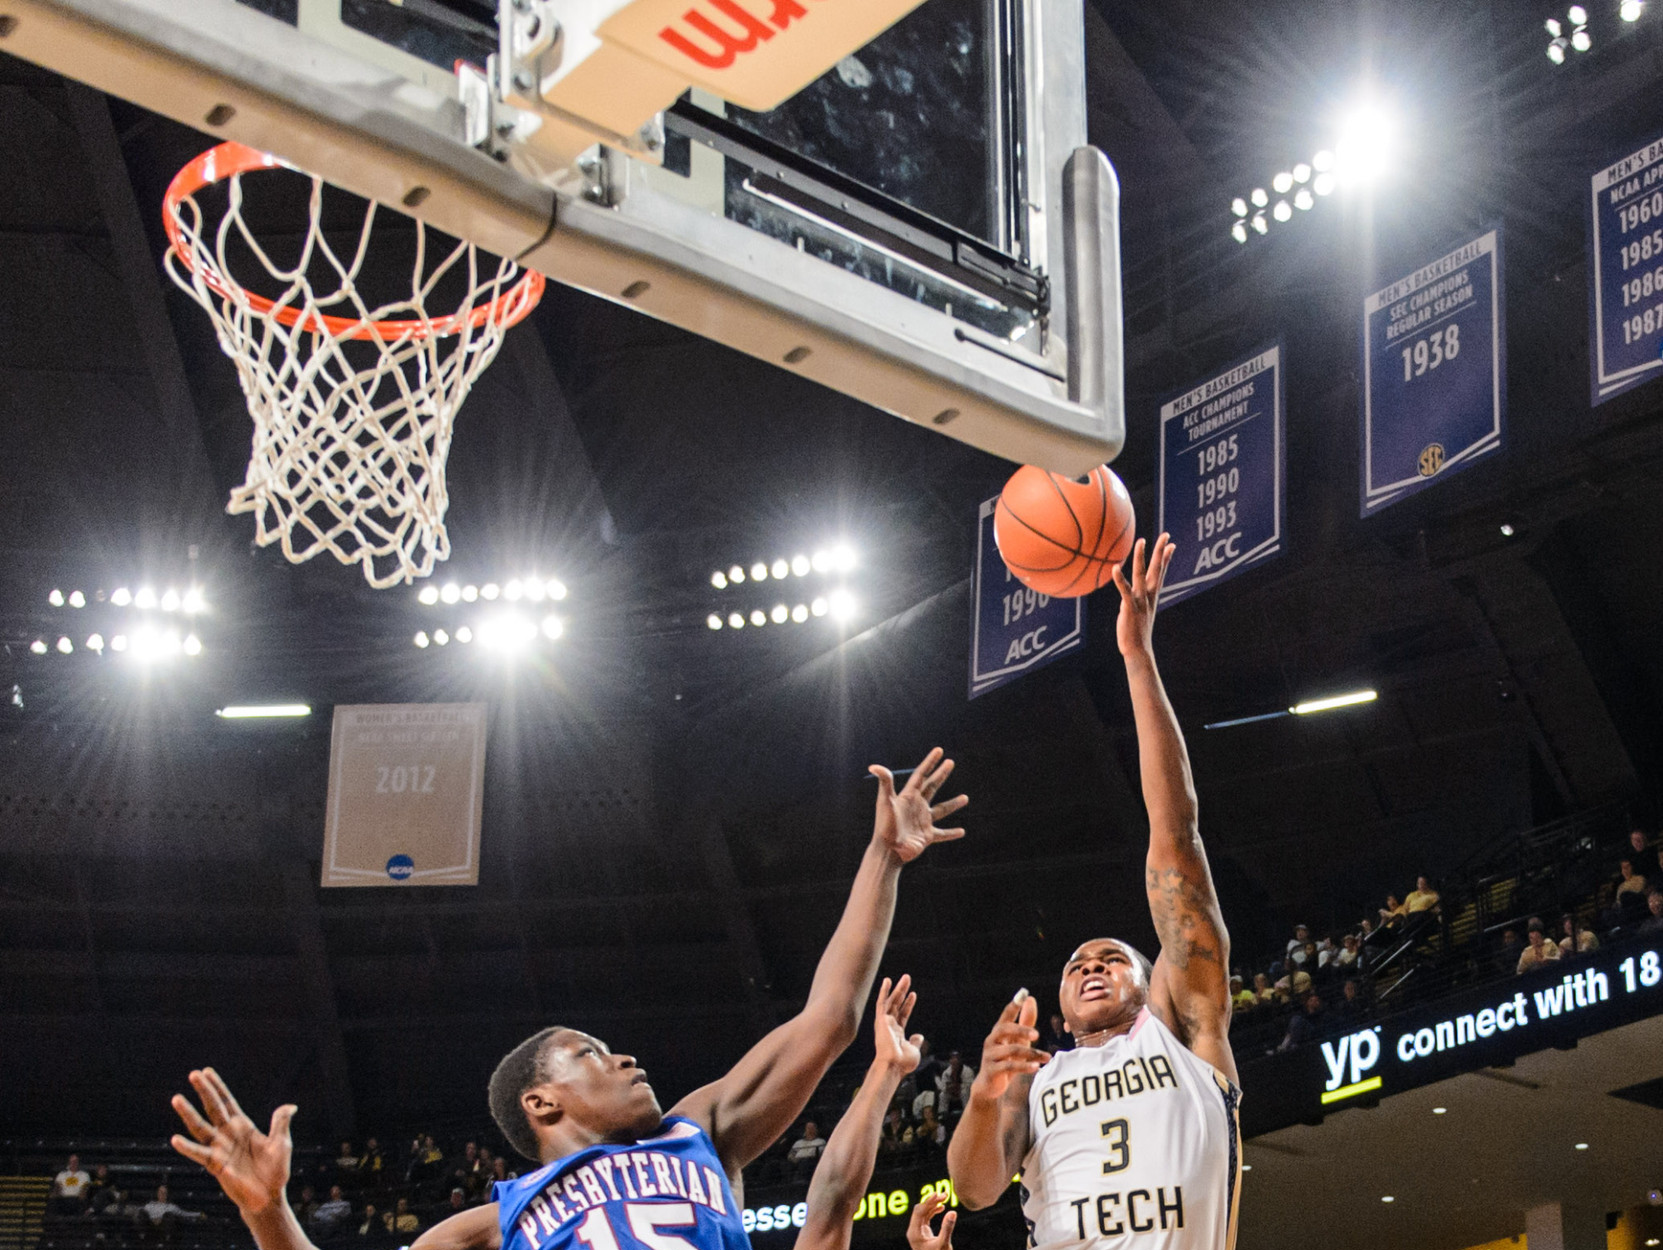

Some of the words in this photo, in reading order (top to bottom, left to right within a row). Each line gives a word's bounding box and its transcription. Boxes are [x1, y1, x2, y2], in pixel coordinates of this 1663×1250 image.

[1608, 151, 1644, 184] MEN'S
[1611, 178, 1640, 204] NCAA
[1619, 192, 1663, 234] 1960
[1414, 241, 1482, 288] BASKETBALL
[1621, 229, 1663, 270] 1985
[1390, 301, 1408, 322] SEC
[1410, 269, 1469, 311] CHAMPIONS
[1622, 266, 1663, 307] 1986
[1386, 306, 1431, 340] REGULAR
[1434, 284, 1473, 317] SEASON
[1623, 303, 1663, 345] 1987
[1402, 324, 1460, 382] 1938
[1172, 389, 1202, 415] MEN'S
[1205, 357, 1266, 398] BASKETBALL
[1182, 410, 1199, 429] ACC
[1201, 381, 1255, 420] CHAMPIONS
[1188, 401, 1249, 441] TOURNAMENT
[1198, 433, 1238, 476] 1985
[1197, 467, 1239, 509] 1990
[1196, 500, 1237, 541] 1993
[1193, 531, 1242, 575] ACC
[1004, 625, 1047, 664] ACC
[375, 766, 436, 794] 2012
[1320, 1027, 1381, 1092] yp
[1397, 992, 1529, 1062] connect
[1533, 967, 1610, 1020] with
[1619, 950, 1662, 993] 18
[1040, 1054, 1179, 1129] GEORGIA
[1100, 1116, 1132, 1177] 3
[1070, 1185, 1185, 1241] TECH
